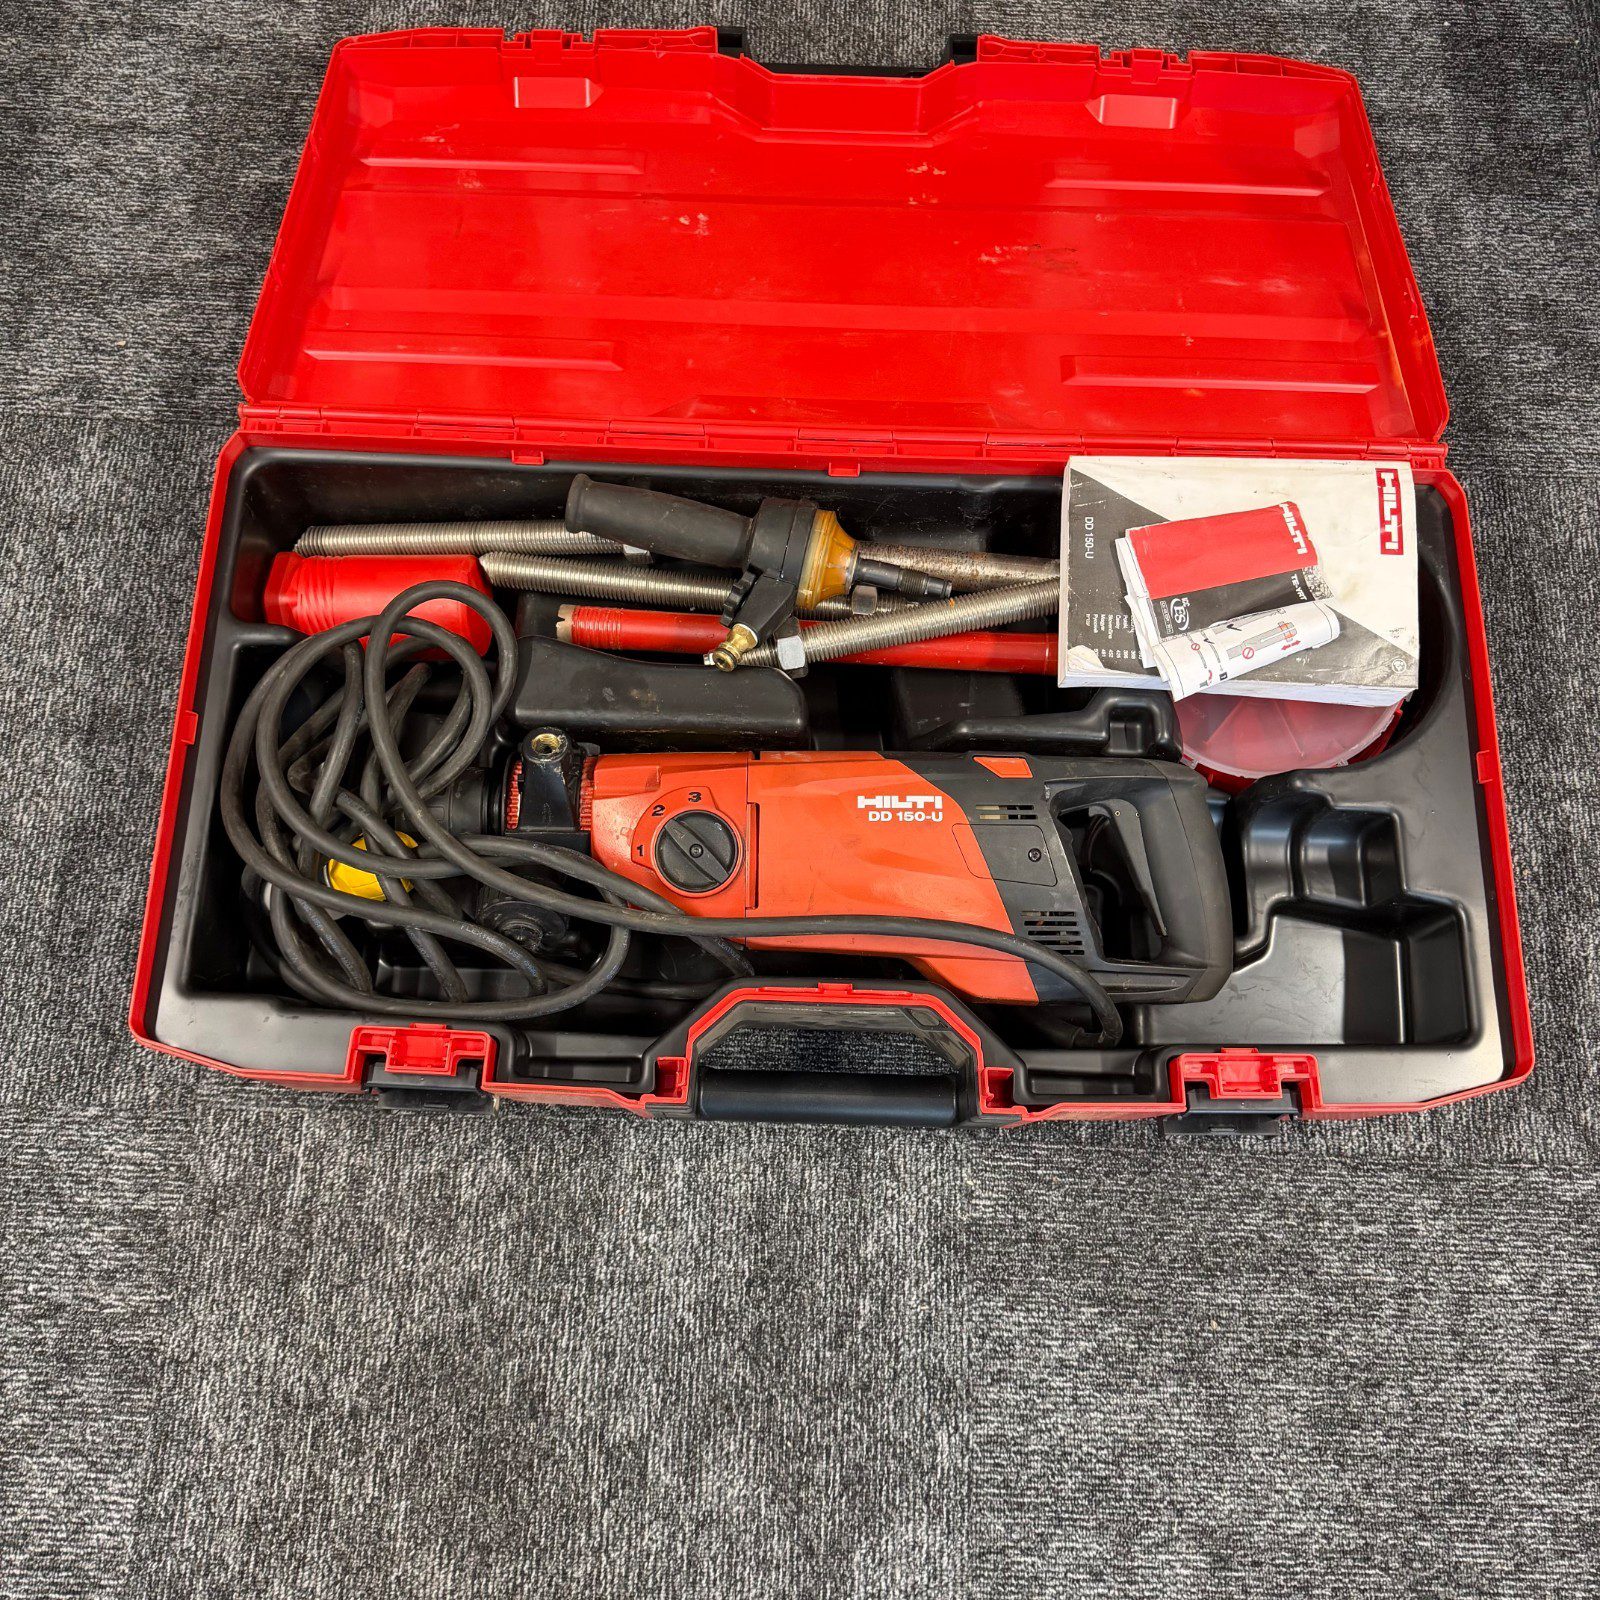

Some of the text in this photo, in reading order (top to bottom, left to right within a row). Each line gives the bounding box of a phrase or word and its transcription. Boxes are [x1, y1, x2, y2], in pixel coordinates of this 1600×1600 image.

[1380, 472, 1399, 550] HILTI
[1279, 502, 1308, 555] HILTI
[1084, 516, 1094, 559] DD 150-U
[1290, 573, 1308, 600] TE-YRT
[1173, 605, 1186, 623] ES
[688, 791, 702, 802] 3
[857, 795, 943, 809] HILTI
[651, 804, 666, 817] 2
[868, 810, 943, 822] DD 150-U
[636, 844, 644, 857] 1
